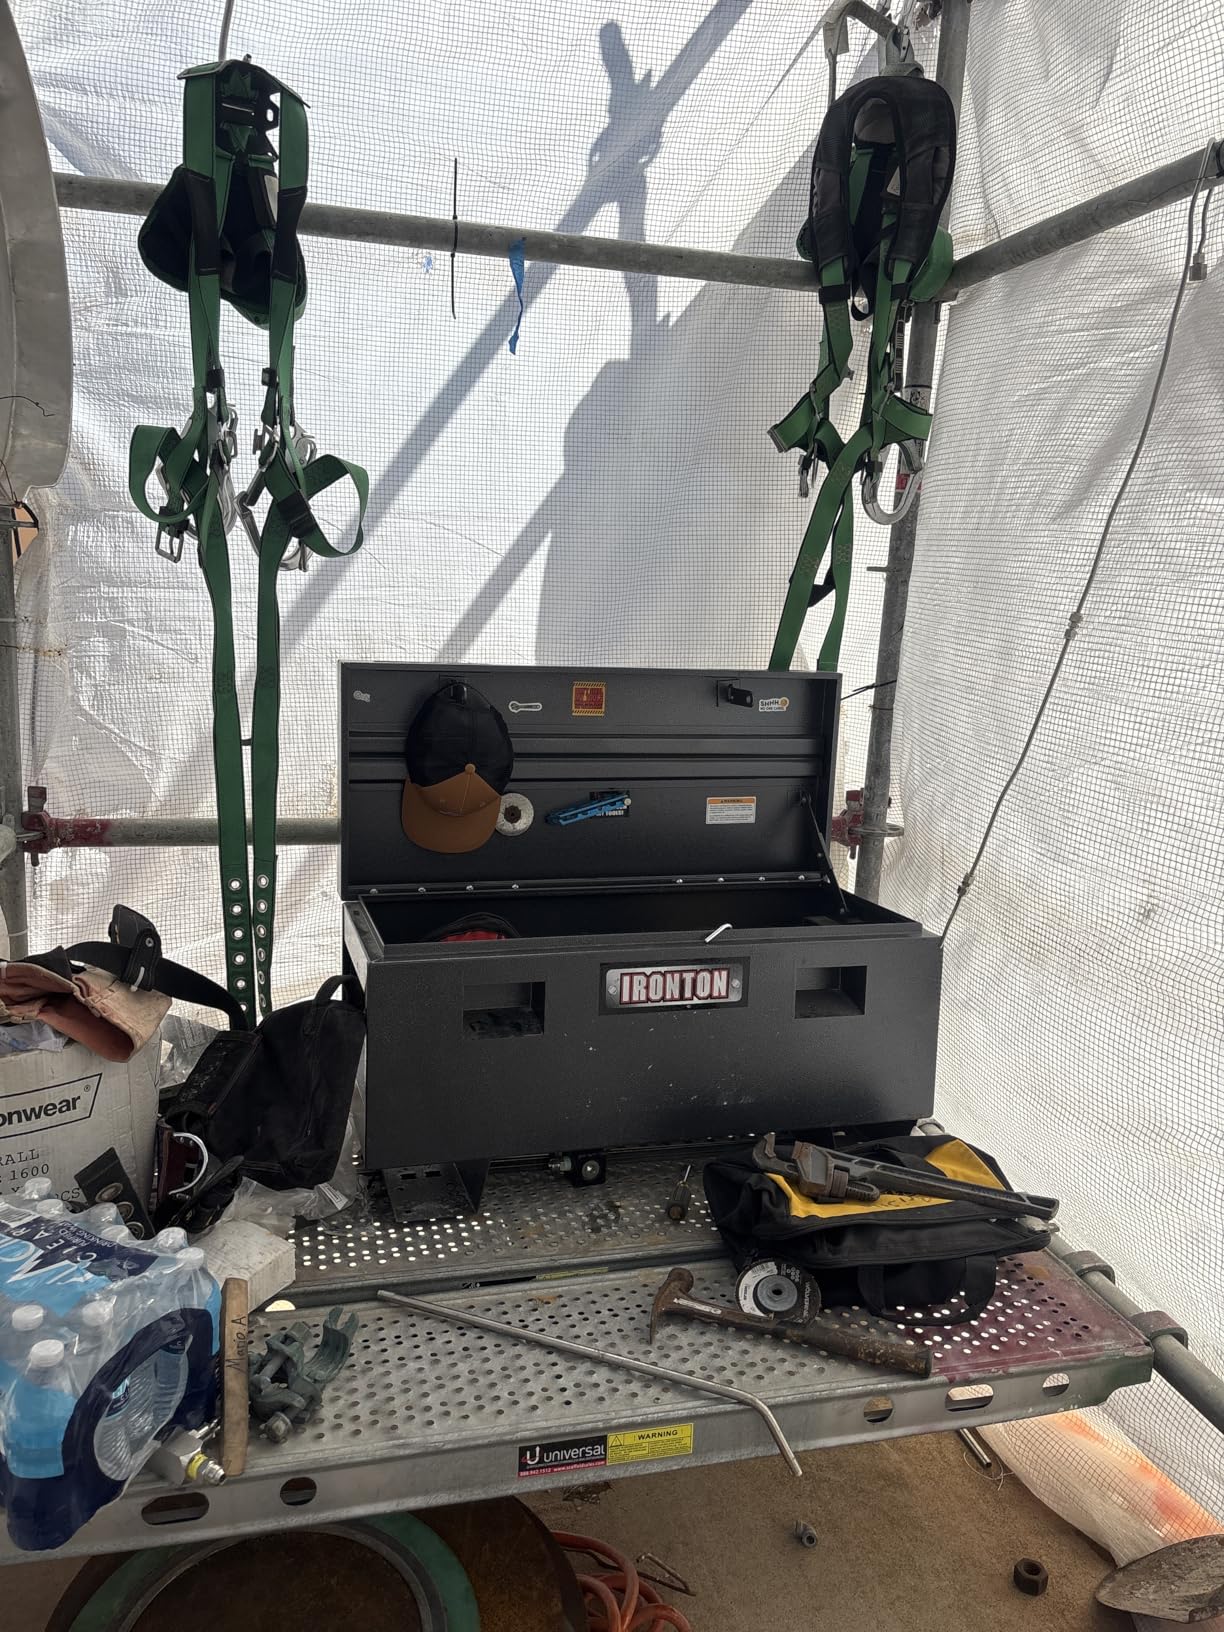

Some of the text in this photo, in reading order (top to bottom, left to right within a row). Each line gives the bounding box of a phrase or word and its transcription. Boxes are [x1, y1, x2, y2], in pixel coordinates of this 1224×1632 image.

[620, 968, 730, 1005] IRONTON
[10, 1163, 49, 1181] 1600
[12, 1227, 97, 1262] CLEAR
[637, 1429, 678, 1441] WARNING
[543, 1444, 605, 1463] universal
